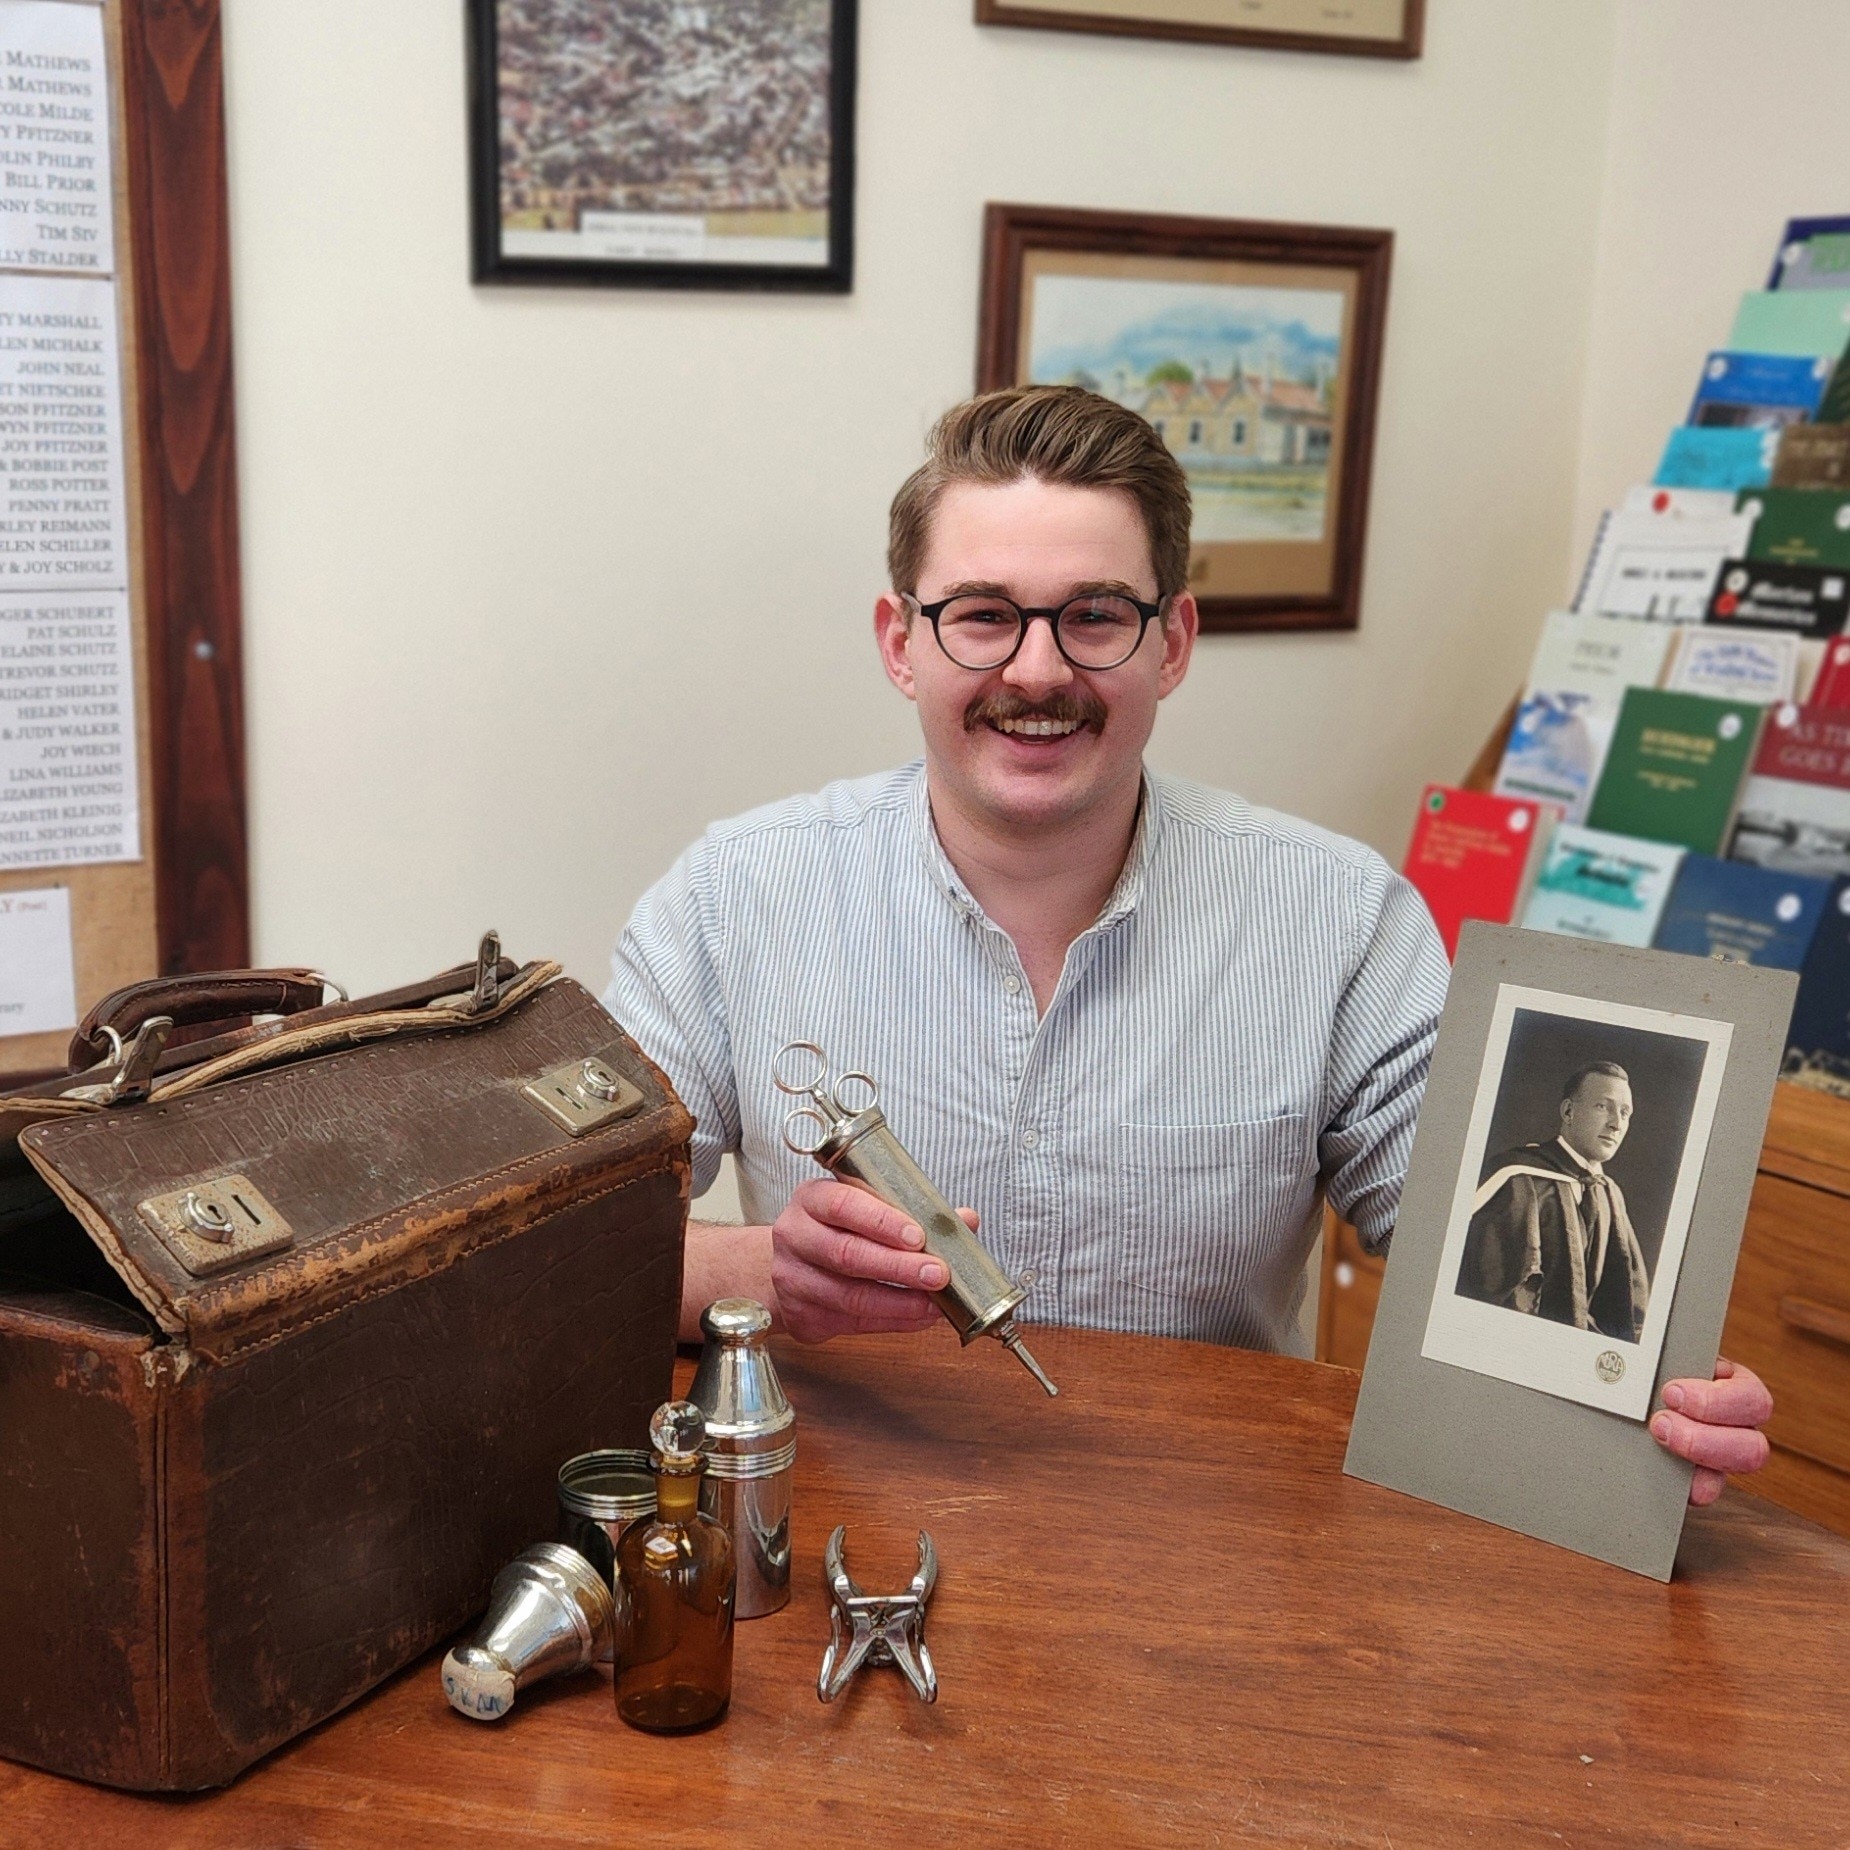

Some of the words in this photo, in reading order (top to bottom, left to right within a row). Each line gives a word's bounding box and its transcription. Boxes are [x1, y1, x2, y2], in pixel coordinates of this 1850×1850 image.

[7, 51, 91, 71] MATHEWS
[8, 76, 92, 96] MATHEWS
[40, 103, 93, 121] MILDE
[16, 125, 93, 144] PFITZNER
[37, 151, 94, 169] PHILBY
[6, 171, 41, 188] BILL
[47, 175, 96, 192] PRIOR
[35, 199, 97, 217] SCHUTZ
[37, 224, 67, 240] TIM
[28, 249, 99, 267] STALDER
[19, 313, 103, 329] MARSHALL
[32, 338, 103, 352] MICHALK
[17, 362, 60, 375] JOHN
[63, 362, 105, 376] NEAL
[18, 383, 106, 398] NIETSCHKE
[33, 403, 106, 417] PFITZNER
[33, 421, 107, 434] PFITZNER
[2, 440, 30, 452] JOY
[35, 440, 108, 453] PFITZNER
[12, 459, 69, 472] BOBBIE
[71, 460, 109, 472] POST
[9, 478, 48, 492] ROSS
[51, 478, 110, 492] POTTER
[8, 500, 59, 513] PENNY
[63, 500, 111, 513] PRATT
[40, 520, 111, 533] REIMANN
[39, 539, 112, 553] SCHILLER
[10, 561, 20, 574] &
[23, 561, 54, 574] JOY
[55, 561, 114, 574] SCHOLZ
[37, 606, 116, 620] SCHUBERT
[27, 626, 55, 639] PAT
[58, 624, 117, 639] SCHULZ
[1, 644, 56, 658] ELAINE
[59, 642, 118, 657] SCHUTZ
[60, 662, 119, 677] SCHUTZ
[56, 684, 119, 699] SHIRLEY
[18, 704, 68, 720] HELEN
[71, 703, 120, 716] VATER
[2, 728, 12, 740] &
[16, 726, 55, 740] JUDY
[59, 723, 121, 737] WALKER
[41, 746, 68, 759] JOY
[71, 743, 121, 757] WIECH
[9, 768, 46, 782] LINA
[49, 763, 122, 779] WILLIAMS
[70, 782, 123, 797] YOUNG
[62, 803, 122, 819] KLEINIG
[37, 823, 122, 840] NICHOLSON
[64, 843, 124, 859] TURNER
